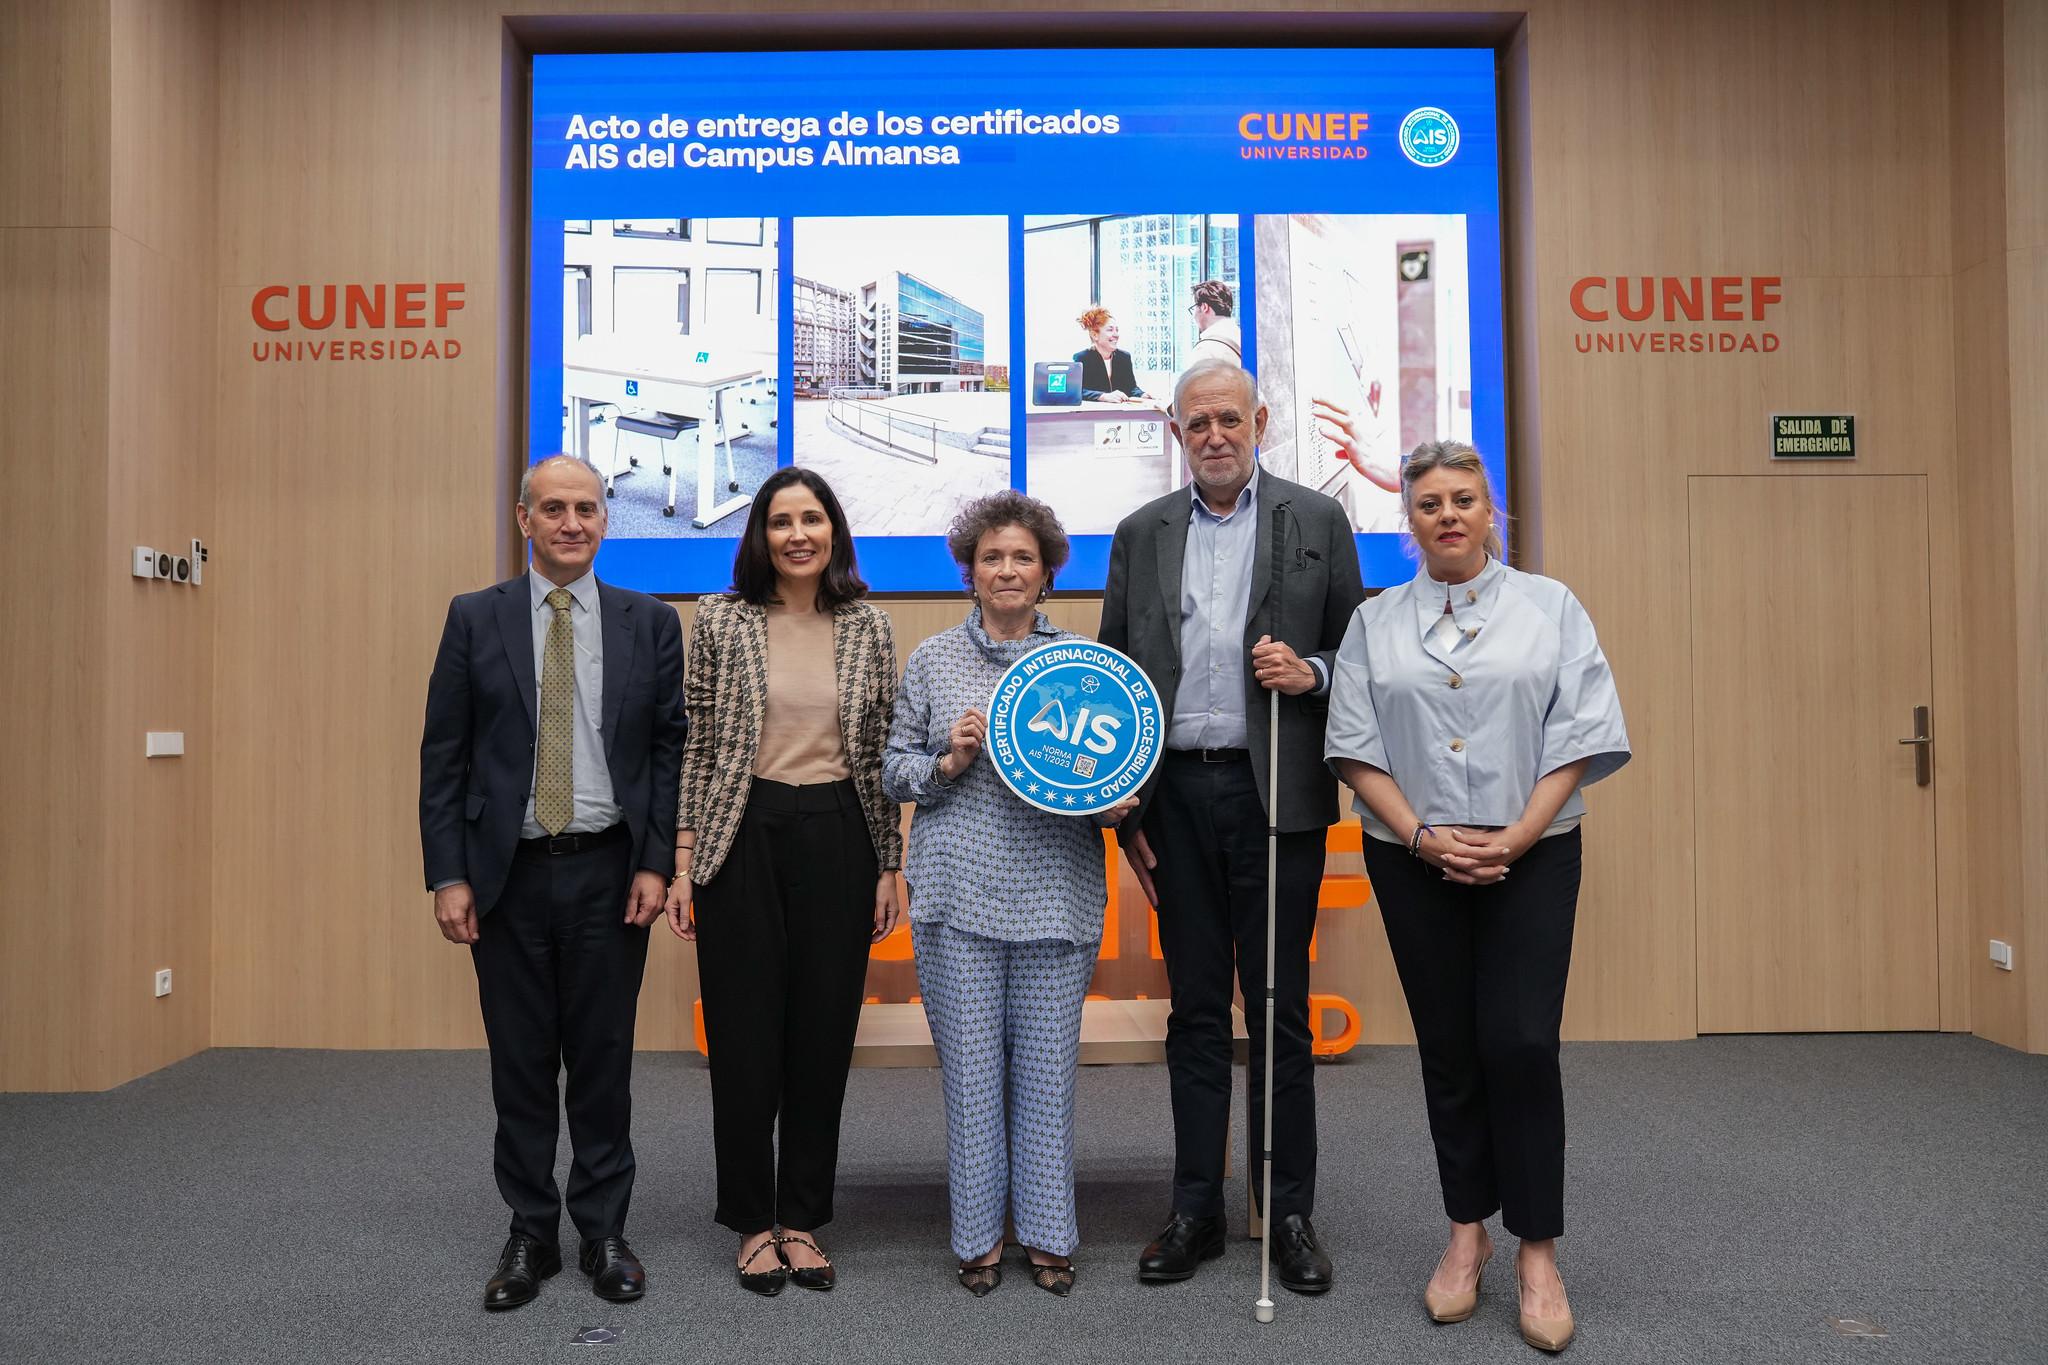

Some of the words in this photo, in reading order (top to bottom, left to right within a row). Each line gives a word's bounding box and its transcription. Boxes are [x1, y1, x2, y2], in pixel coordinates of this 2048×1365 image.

[564, 114, 640, 140] Acto
[648, 113, 688, 139] de
[696, 113, 821, 143] entrega
[828, 111, 869, 136] de
[877, 110, 923, 136] los
[930, 108, 1121, 136] certificados
[1238, 112, 1369, 142] CUNEF
[1412, 128, 1447, 145] AIS
[564, 144, 619, 170] AIS
[626, 143, 675, 169] del
[683, 142, 814, 174] Campus
[821, 141, 961, 167] Almansa
[1240, 146, 1368, 159] UNIVERSIDAD
[251, 282, 465, 331] CUNEF
[1570, 276, 1782, 322] CUNEF
[252, 339, 462, 362] UNIVERSIDAD
[1575, 332, 1780, 353] UNIVERSIDAD
[1779, 419, 1822, 435] SALIDA
[1831, 419, 1848, 435] DE
[1776, 437, 1851, 453] EMERGENCIA
[1023, 648, 1131, 682] INTERNACIONAL
[1130, 680, 1148, 702] DE
[994, 675, 1023, 766] CERTIFICADO
[1027, 699, 1122, 755] AIS
[1028, 749, 1042, 759] AIS
[1044, 753, 1071, 768] 1/2023
[1042, 744, 1072, 760] NORMA
[1100, 705, 1155, 799] ACCESIBILIDAD
